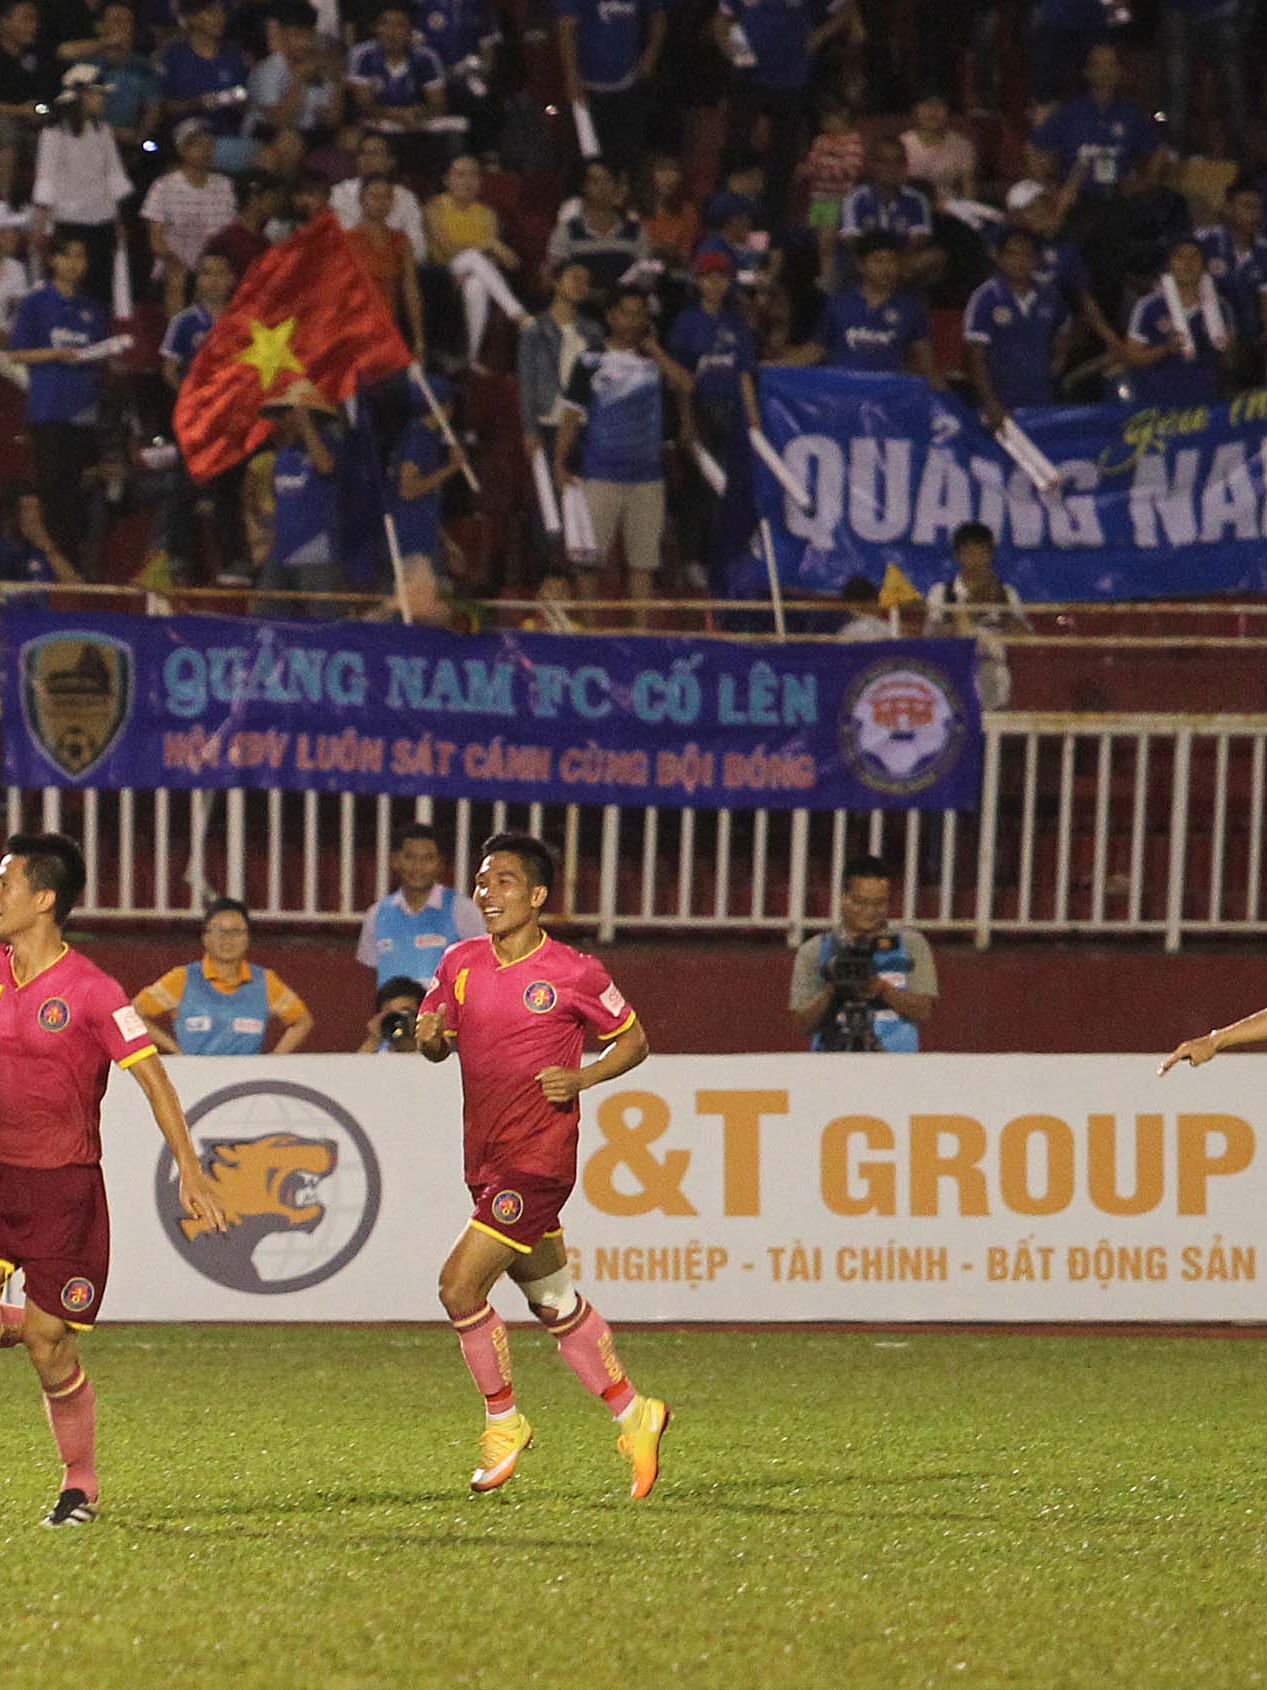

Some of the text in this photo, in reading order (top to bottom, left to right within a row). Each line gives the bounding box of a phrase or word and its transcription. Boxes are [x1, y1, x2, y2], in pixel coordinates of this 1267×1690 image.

[1128, 438, 1267, 549] NA
[162, 624, 819, 726] QUẢNG NAM FC CỐ LÊN
[296, 726, 385, 775] LUÔN
[390, 731, 458, 778] SÁT
[464, 735, 553, 783] CÁNH
[559, 740, 649, 788] CÙNG
[820, 1114, 1256, 1217] GROUP
[595, 1239, 729, 1290] NGHIỆP
[767, 1239, 822, 1281] TÀI
[836, 1239, 949, 1283] CHÍNH
[987, 1234, 1055, 1283] BẤT
[1067, 1239, 1168, 1290] ĐỘNG
[1180, 1235, 1257, 1281] SẢN
